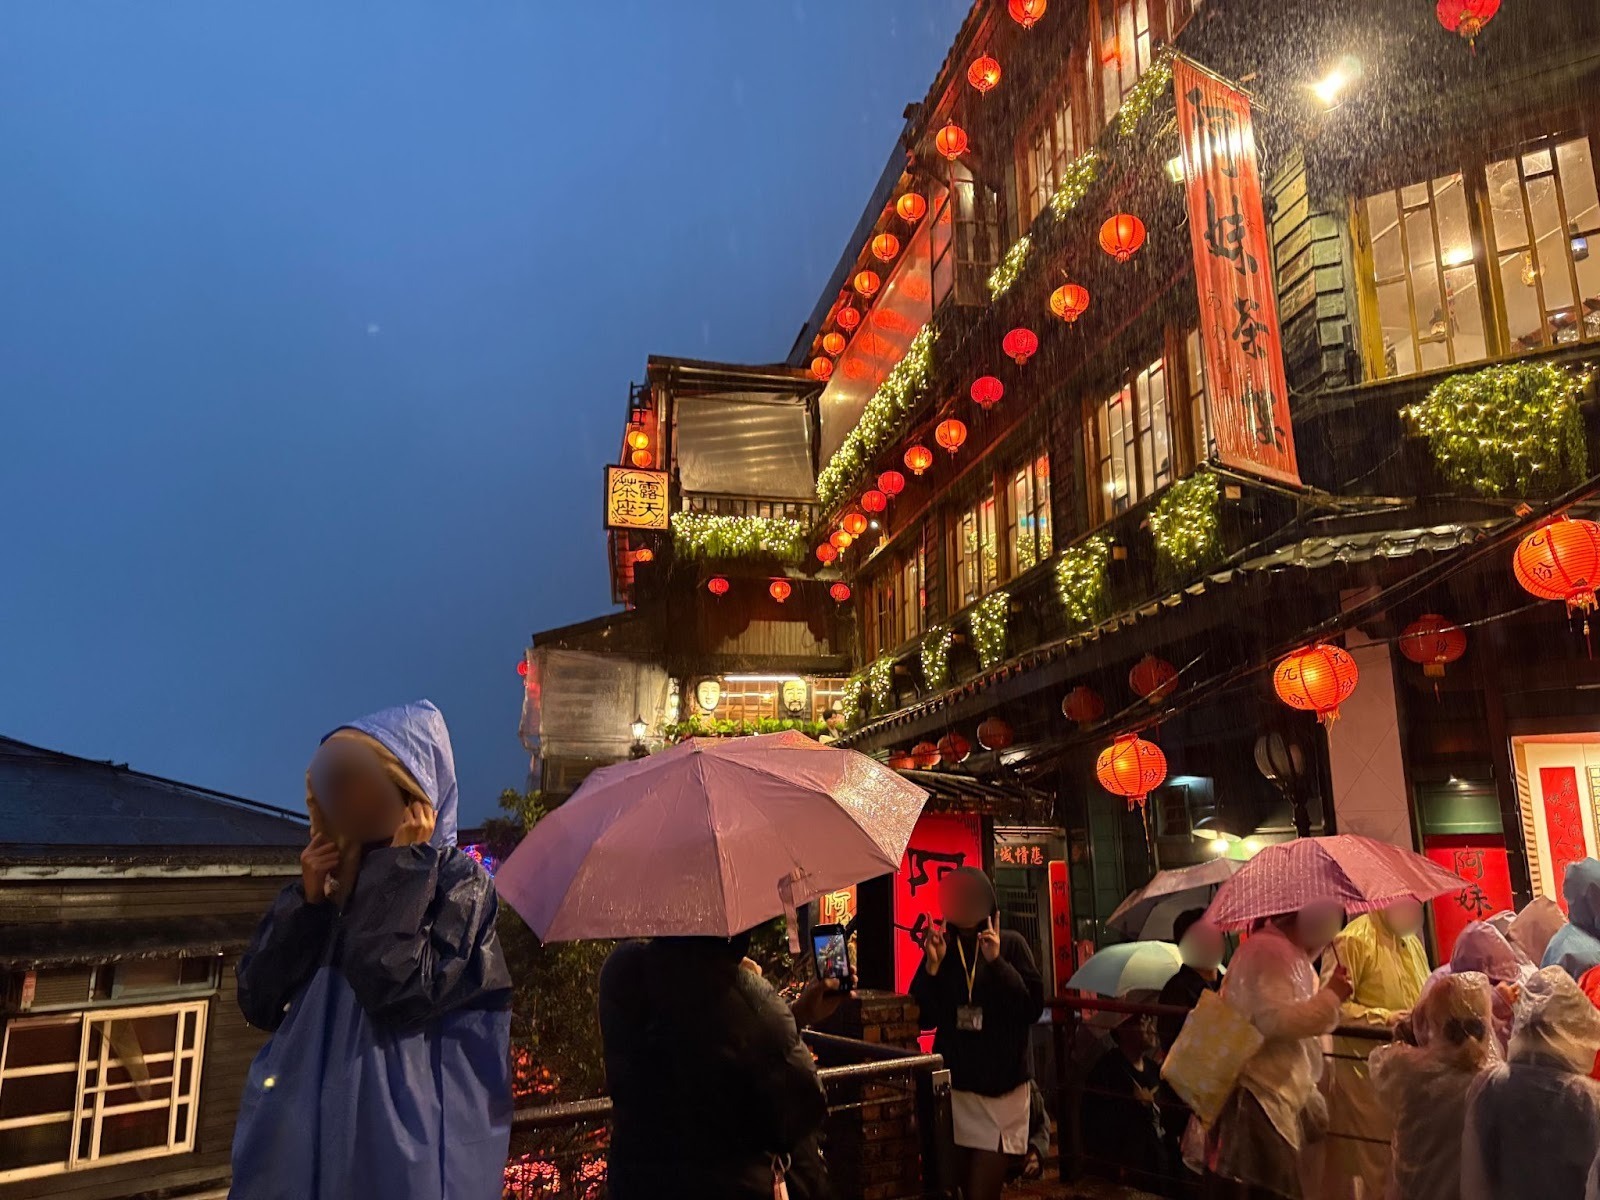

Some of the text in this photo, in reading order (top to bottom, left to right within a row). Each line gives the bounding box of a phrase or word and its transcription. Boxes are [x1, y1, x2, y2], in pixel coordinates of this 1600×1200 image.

[612, 477, 638, 517] 茶座
[638, 480, 663, 518] 露天
[1525, 534, 1555, 582] 九份
[1333, 652, 1354, 694] 九份
[1142, 745, 1158, 783] 九份
